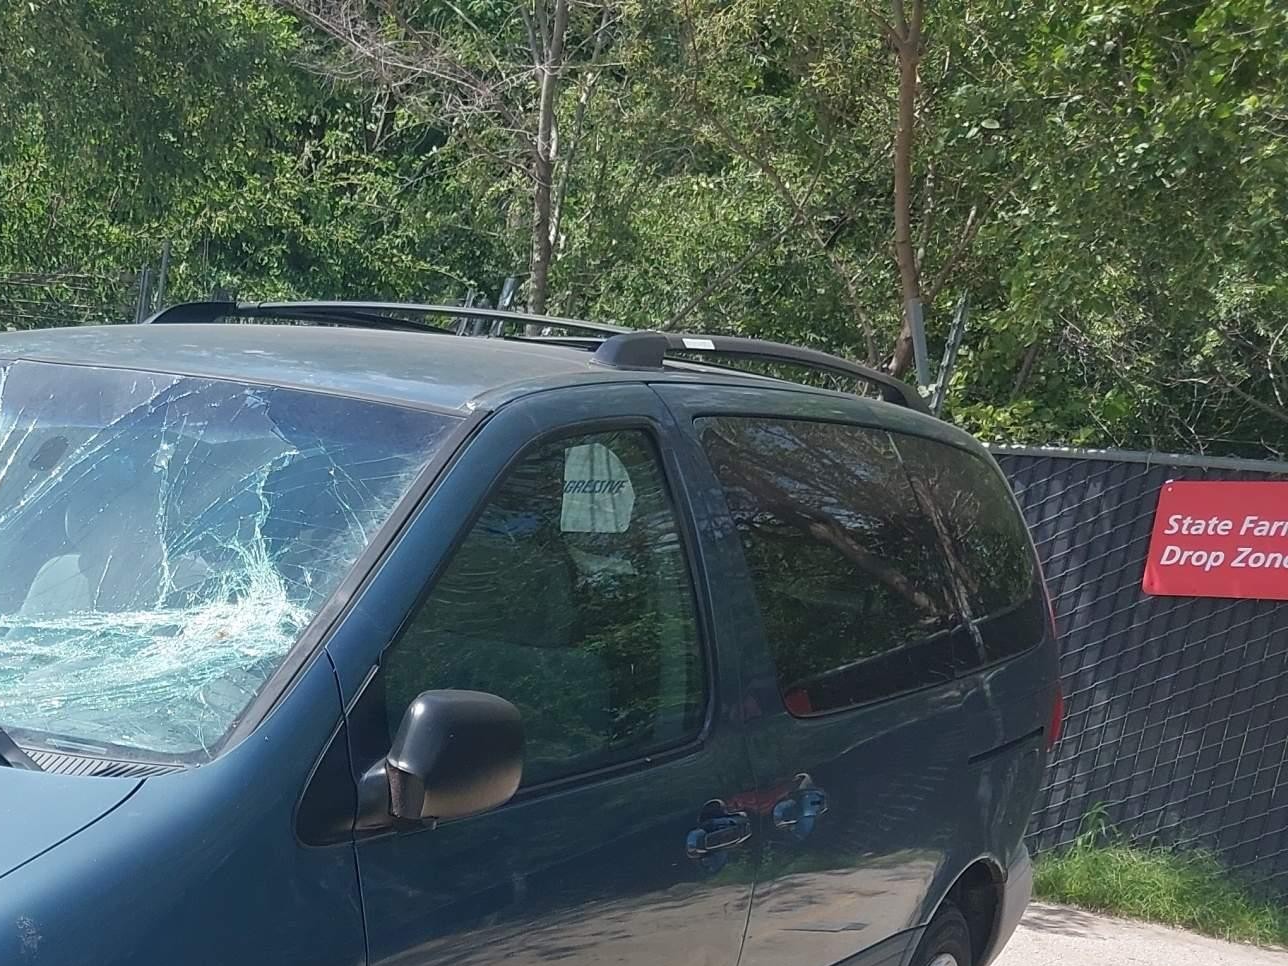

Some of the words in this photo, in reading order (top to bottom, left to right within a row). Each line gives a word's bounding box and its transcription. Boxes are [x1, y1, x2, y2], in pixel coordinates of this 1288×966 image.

[563, 479, 629, 494] GRESSIVE
[1163, 514, 1233, 536] State
[1159, 545, 1225, 571] Drop
